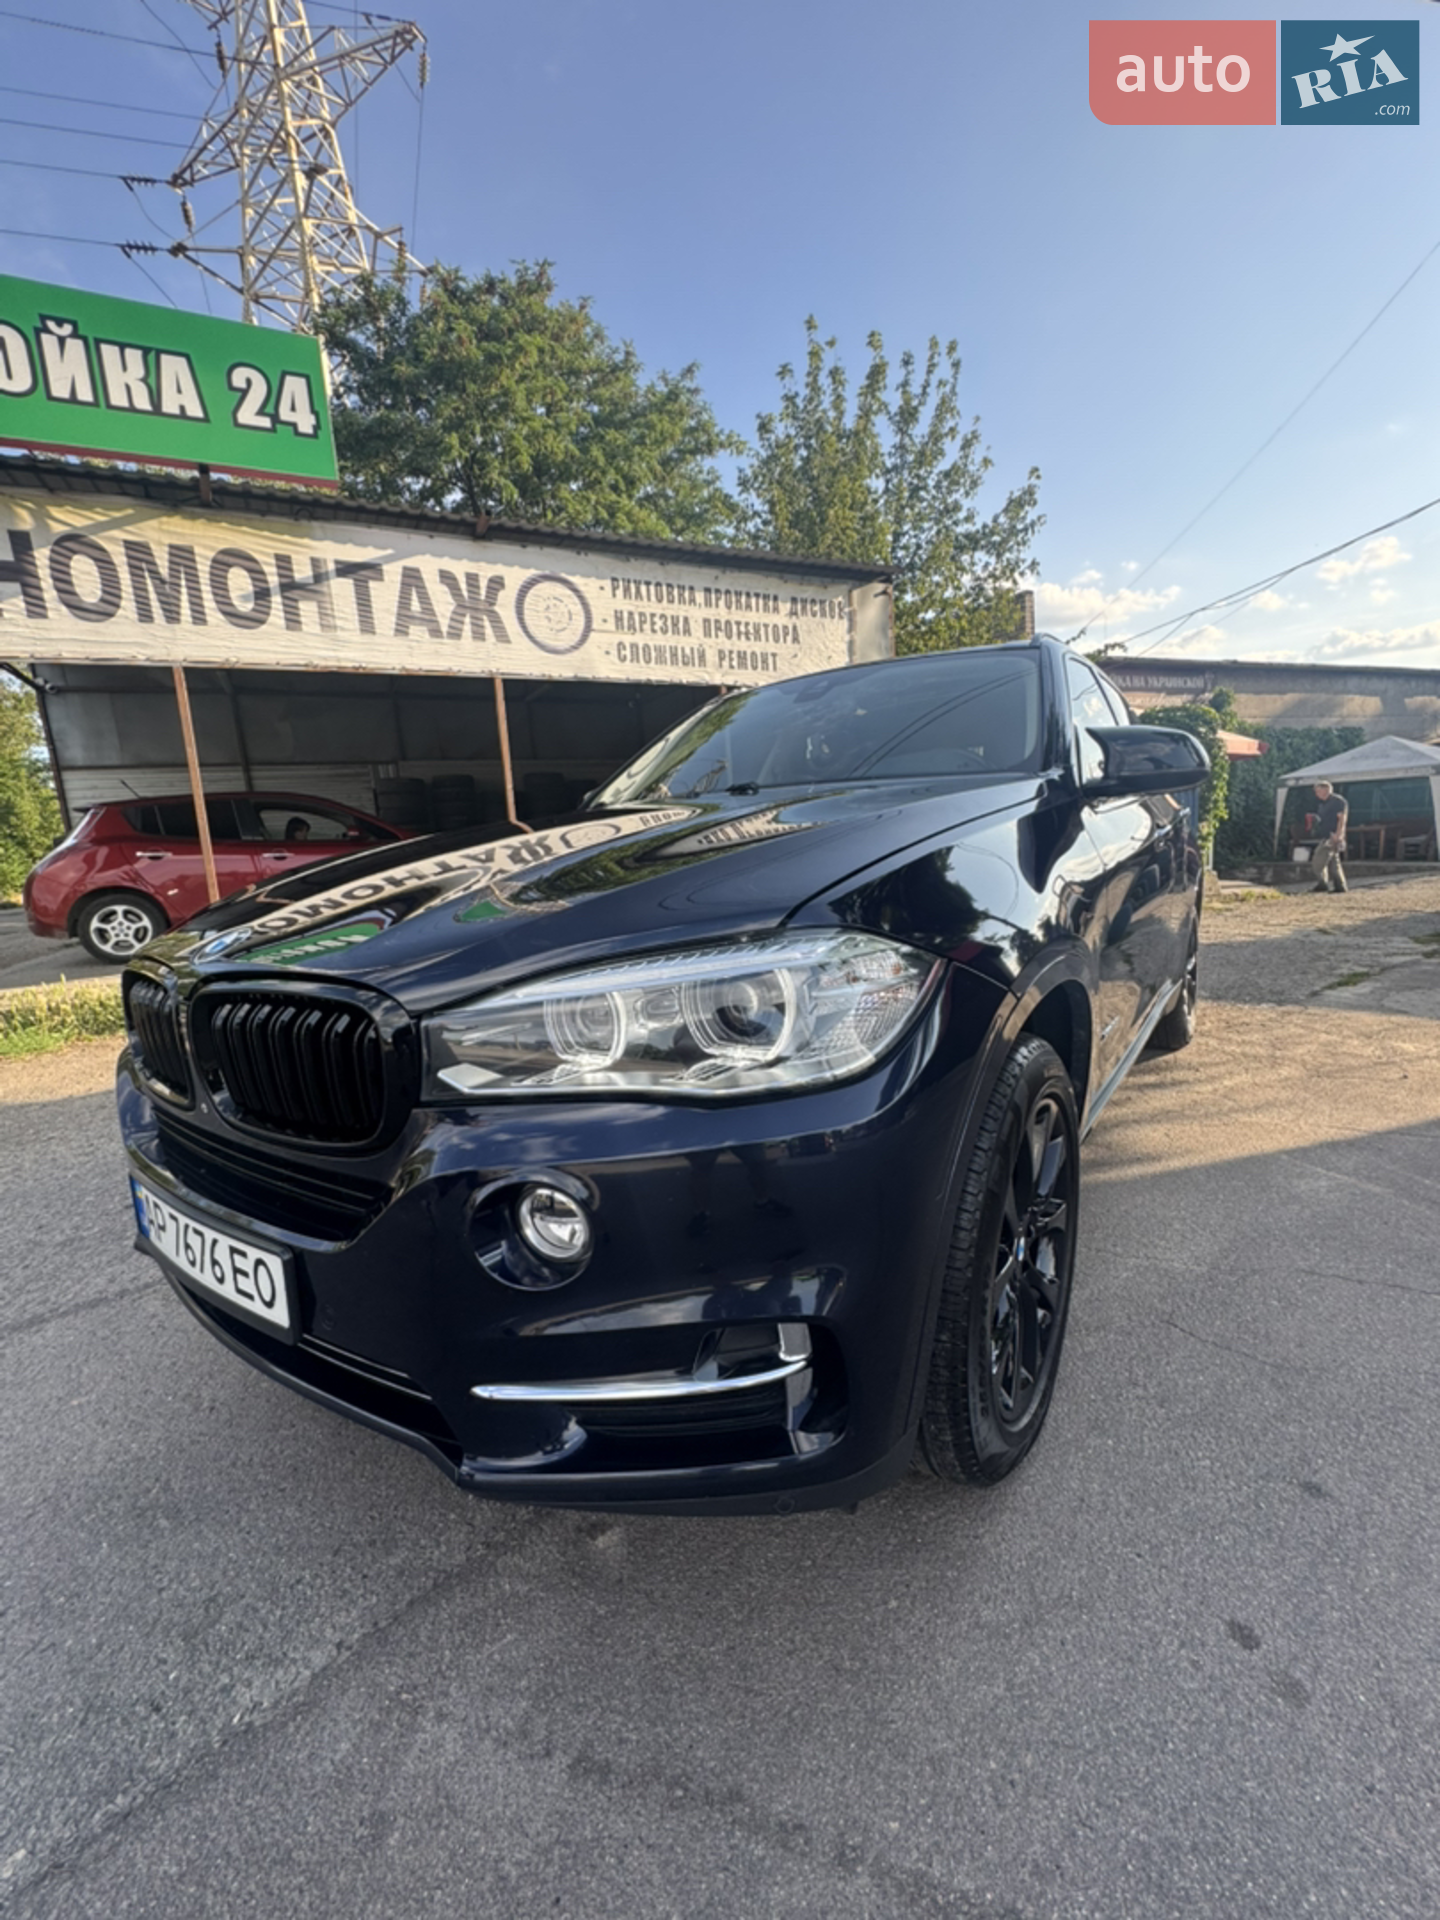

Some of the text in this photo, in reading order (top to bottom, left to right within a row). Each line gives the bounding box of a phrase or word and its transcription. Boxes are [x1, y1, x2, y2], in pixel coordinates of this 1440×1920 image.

[228, 362, 320, 438] 24
[614, 610, 801, 645] НАРЕЗКА ПРОТЕКТОРА
[617, 641, 778, 672] СЛОЖНЫЙ РЕМОНТ
